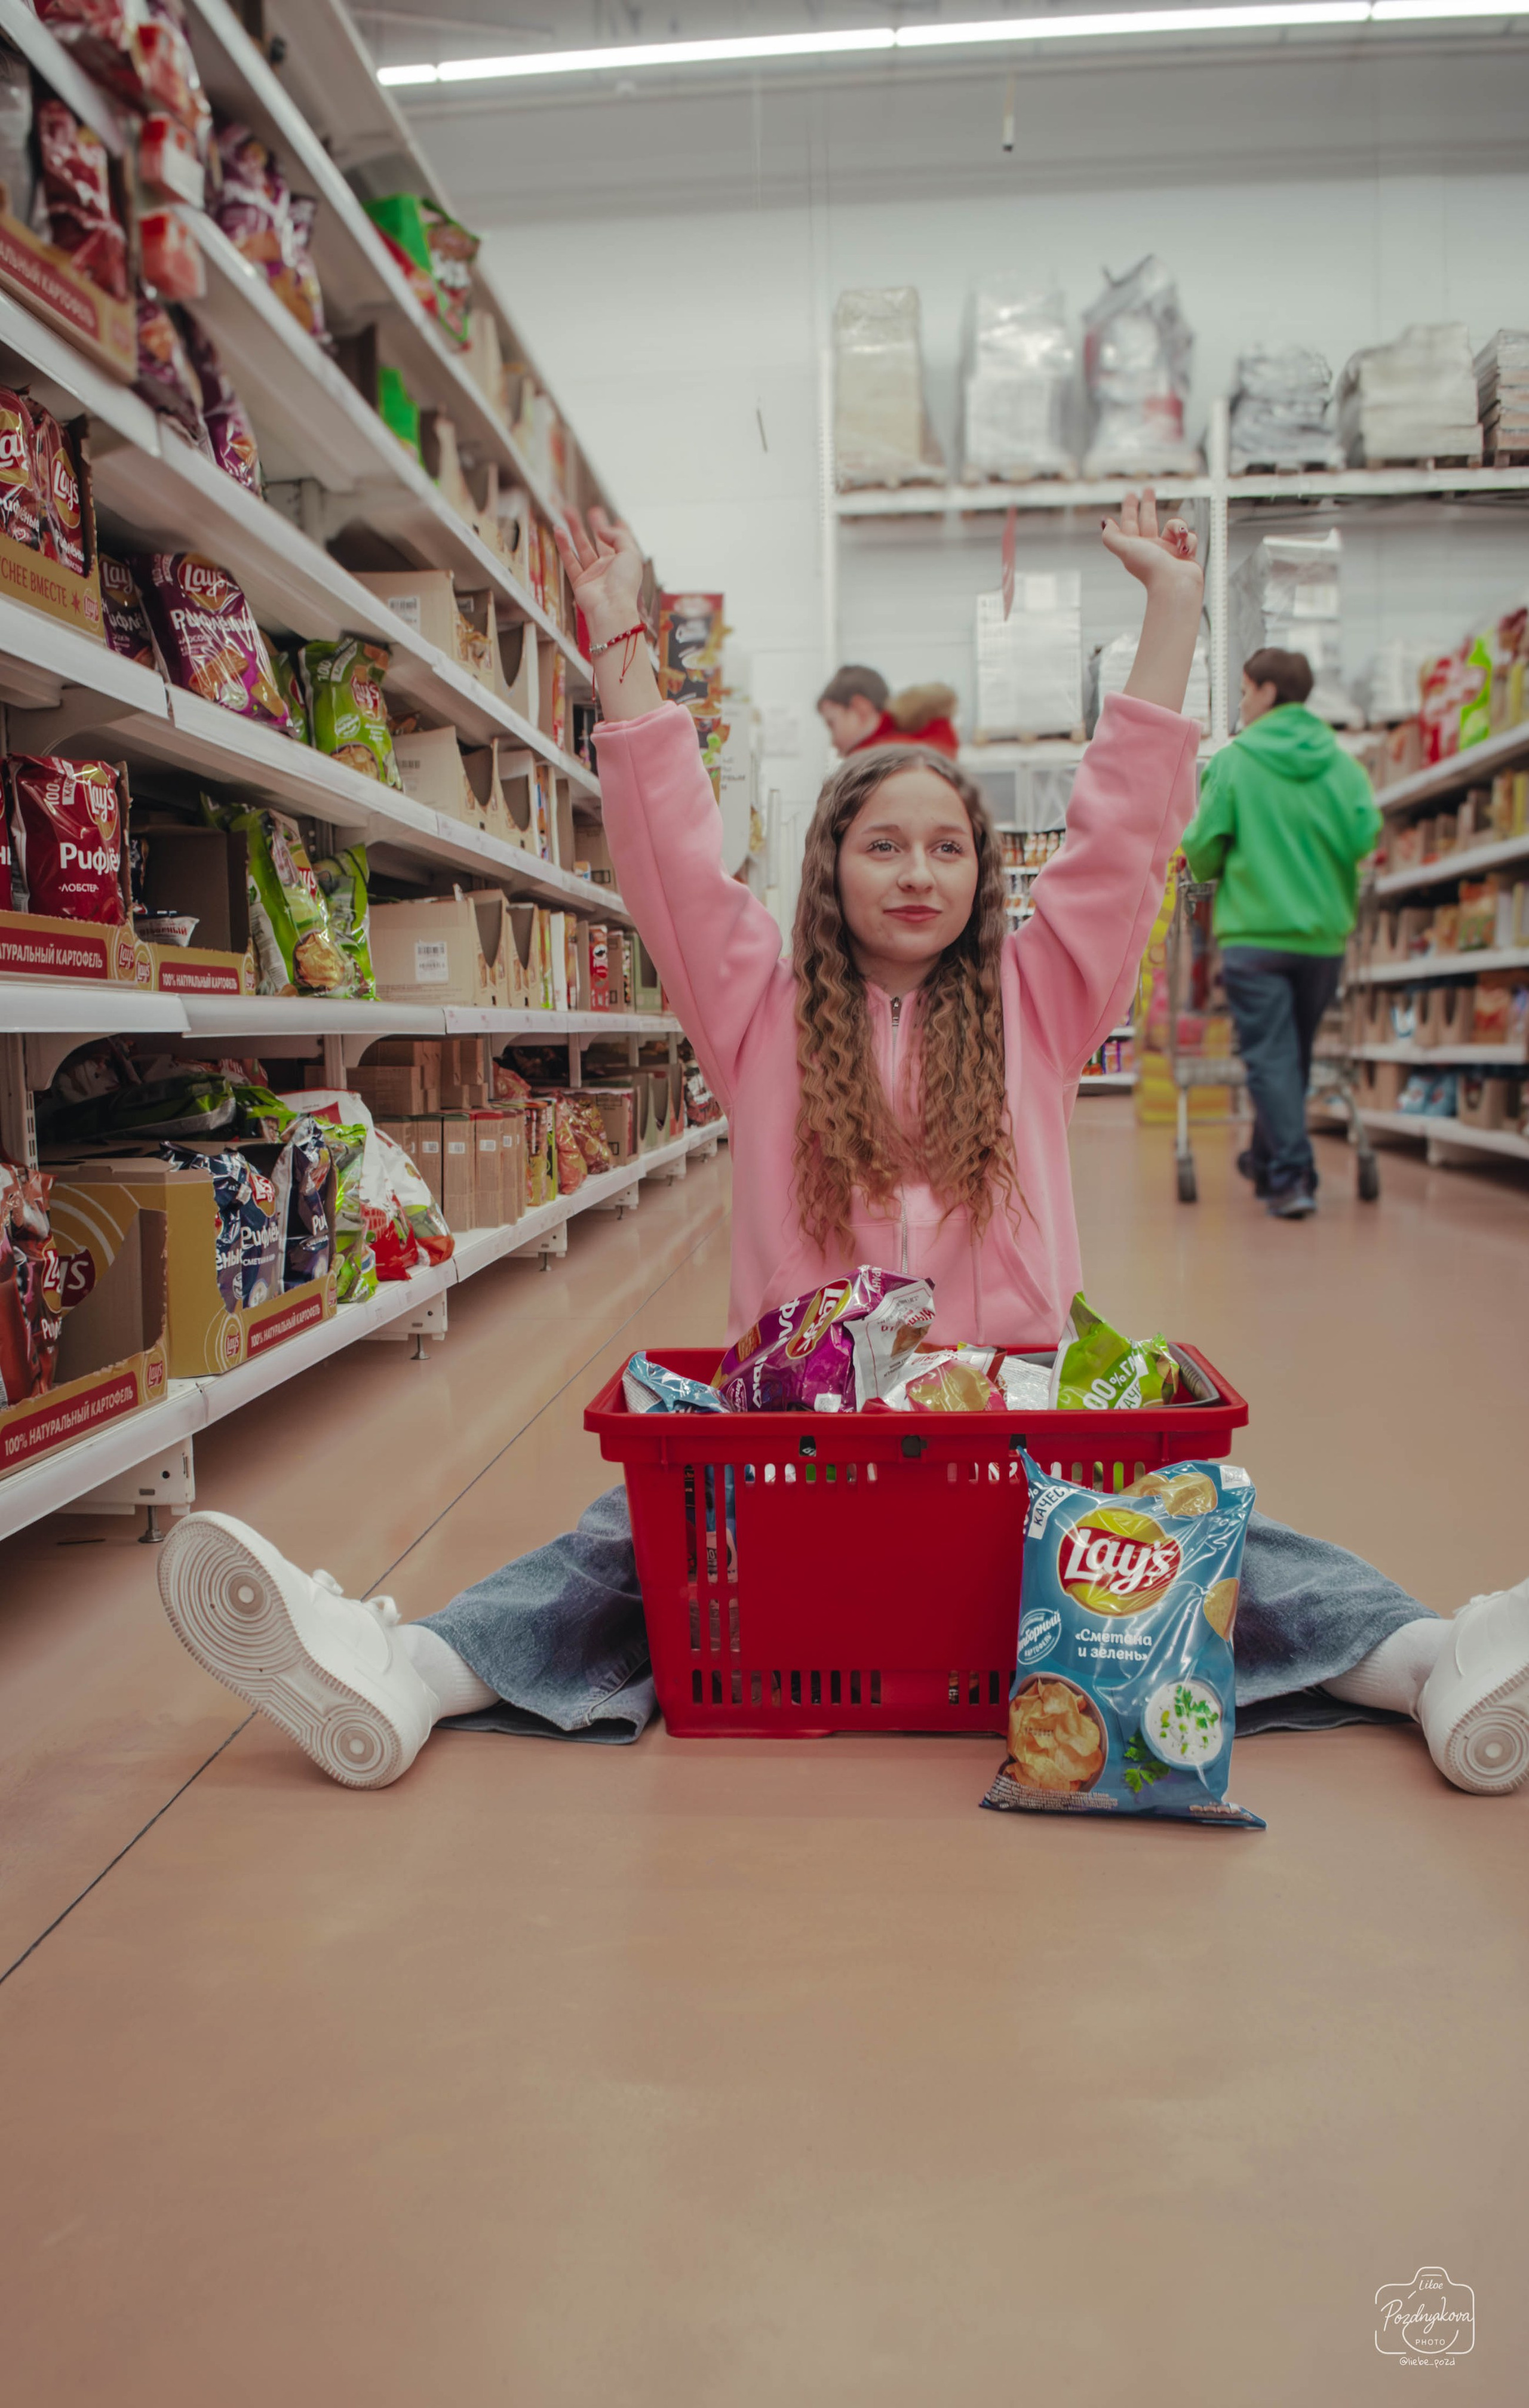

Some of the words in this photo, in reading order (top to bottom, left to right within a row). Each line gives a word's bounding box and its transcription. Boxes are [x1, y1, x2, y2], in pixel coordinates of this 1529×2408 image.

[0, 555, 28, 589] СНЕЕ
[30, 571, 67, 608] ВМЕСТЕ
[90, 781, 115, 823] Lay's
[56, 948, 103, 968] КАРТОФЕЛЬ
[176, 973, 210, 989] НАТУРАЛЬНЫЙ
[211, 977, 238, 990] КАРТОФЕЛЬ
[263, 1312, 296, 1342] НАТУРАЛЬНЫЙ
[296, 1304, 320, 1325] КАРТОФЕЛЬ
[5, 1432, 27, 1456] 100%
[29, 1401, 90, 1446] НАТУРАЛЬНЫЙ
[91, 1385, 133, 1417] КАРТОФЕЛЬ
[1064, 1527, 1175, 1595] Lay's
[1075, 1628, 1152, 1646] «Сметана
[1078, 1647, 1086, 1657] и
[1090, 1648, 1149, 1662] зелень»
